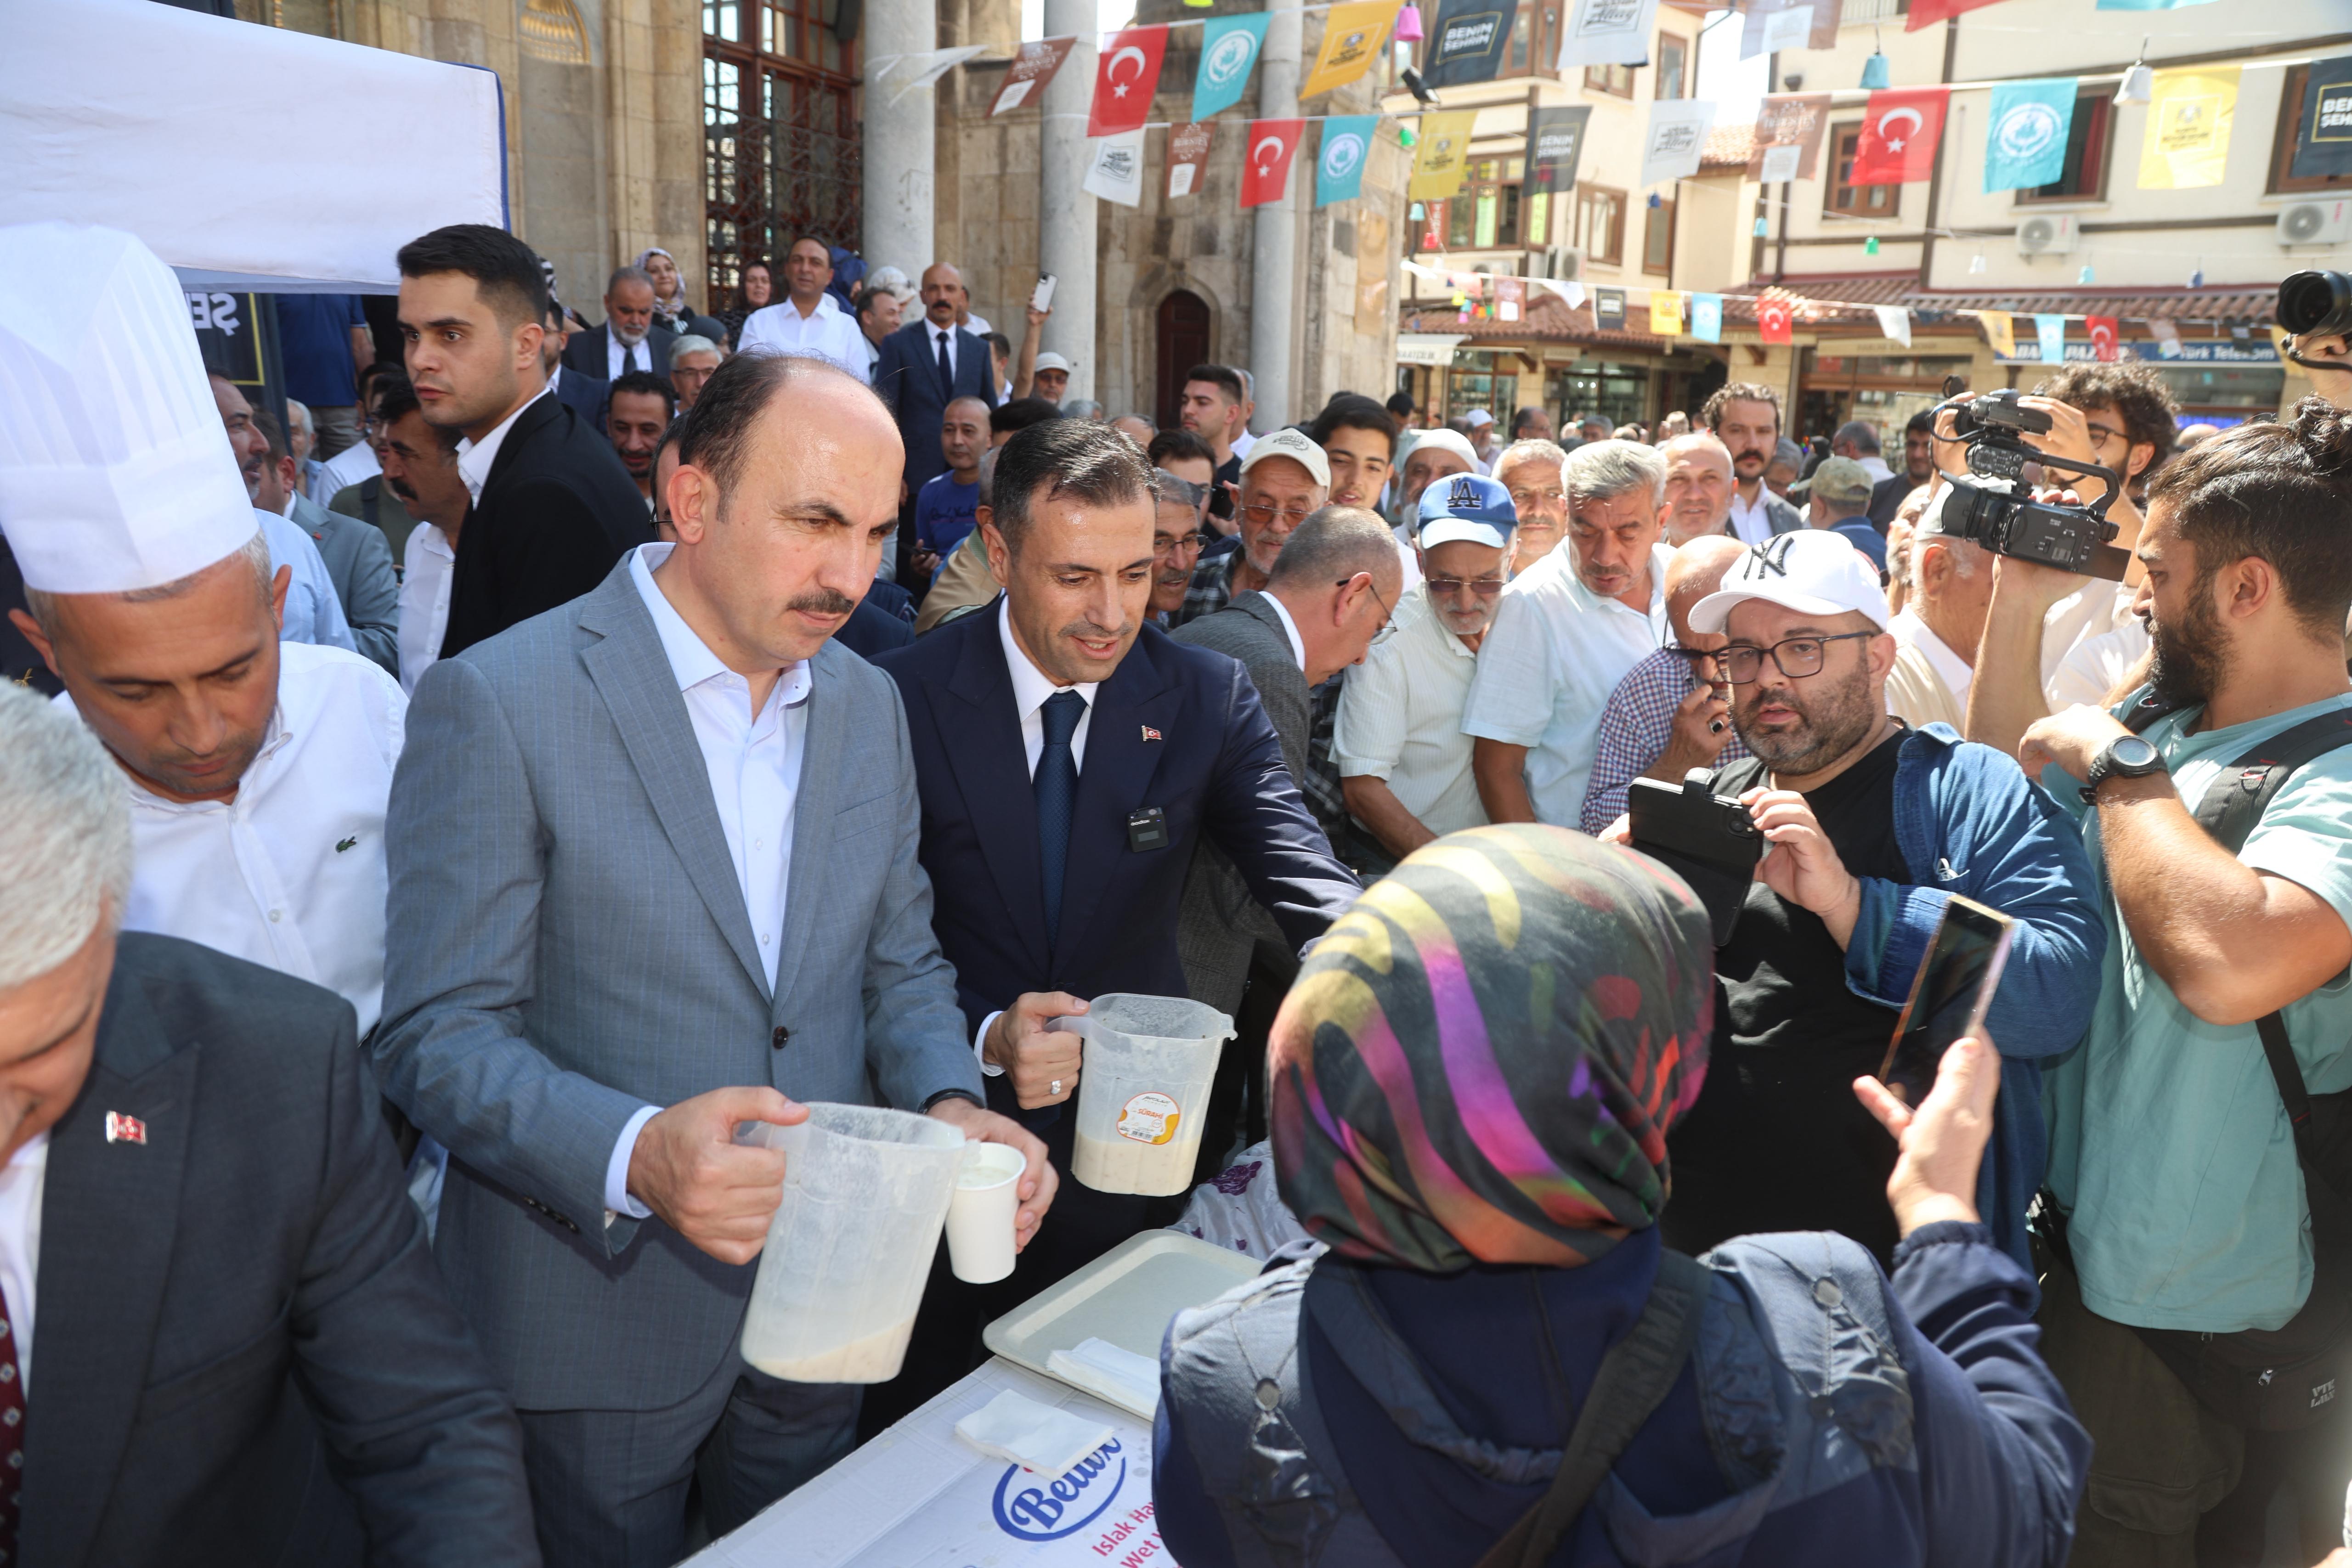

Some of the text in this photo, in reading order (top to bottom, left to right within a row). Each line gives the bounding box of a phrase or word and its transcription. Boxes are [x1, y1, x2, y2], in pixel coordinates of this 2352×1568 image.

[1446, 22, 1494, 40] BENİM
[1539, 135, 1574, 147] BENİM
[1447, 478, 1482, 510] LA
[1743, 534, 1795, 581] NY
[1137, 1107, 1164, 1119] SÜRAHİ
[1091, 1501, 1155, 1557] Islak Ha
[1119, 1539, 1160, 1568] Wet
